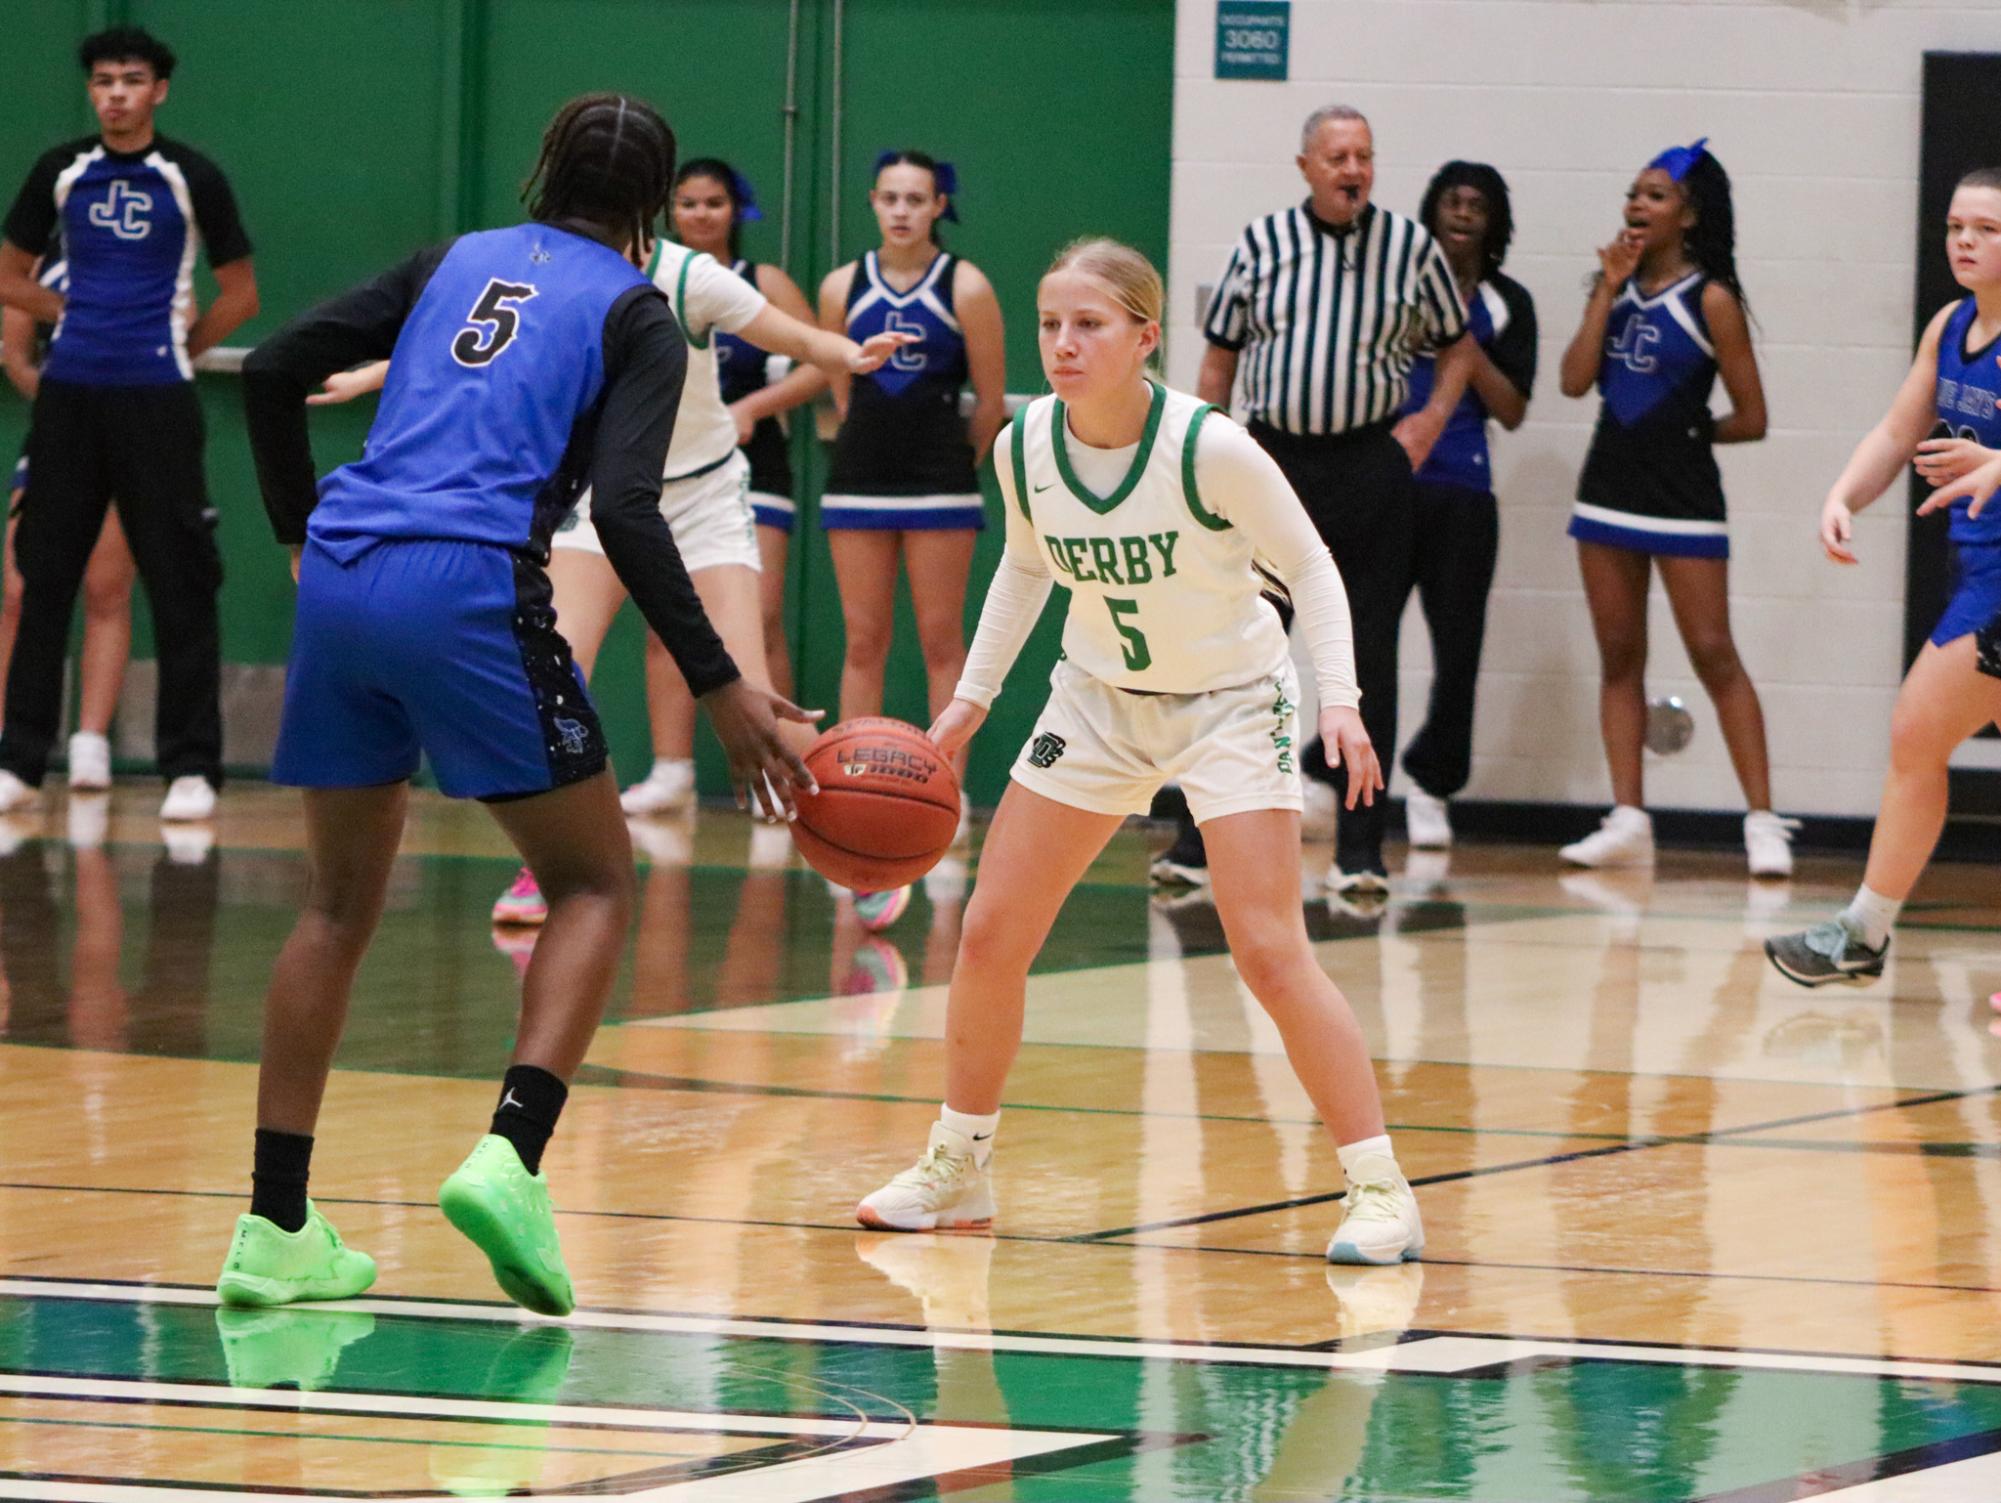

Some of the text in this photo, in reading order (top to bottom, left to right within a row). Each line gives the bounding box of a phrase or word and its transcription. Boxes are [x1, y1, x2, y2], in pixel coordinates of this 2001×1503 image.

[88, 180, 153, 239] JC
[450, 277, 540, 368] 5
[1605, 313, 1661, 373] JC
[1044, 531, 1179, 585] DERBY
[1102, 594, 1152, 671] 5
[837, 748, 937, 775] LEGACY
